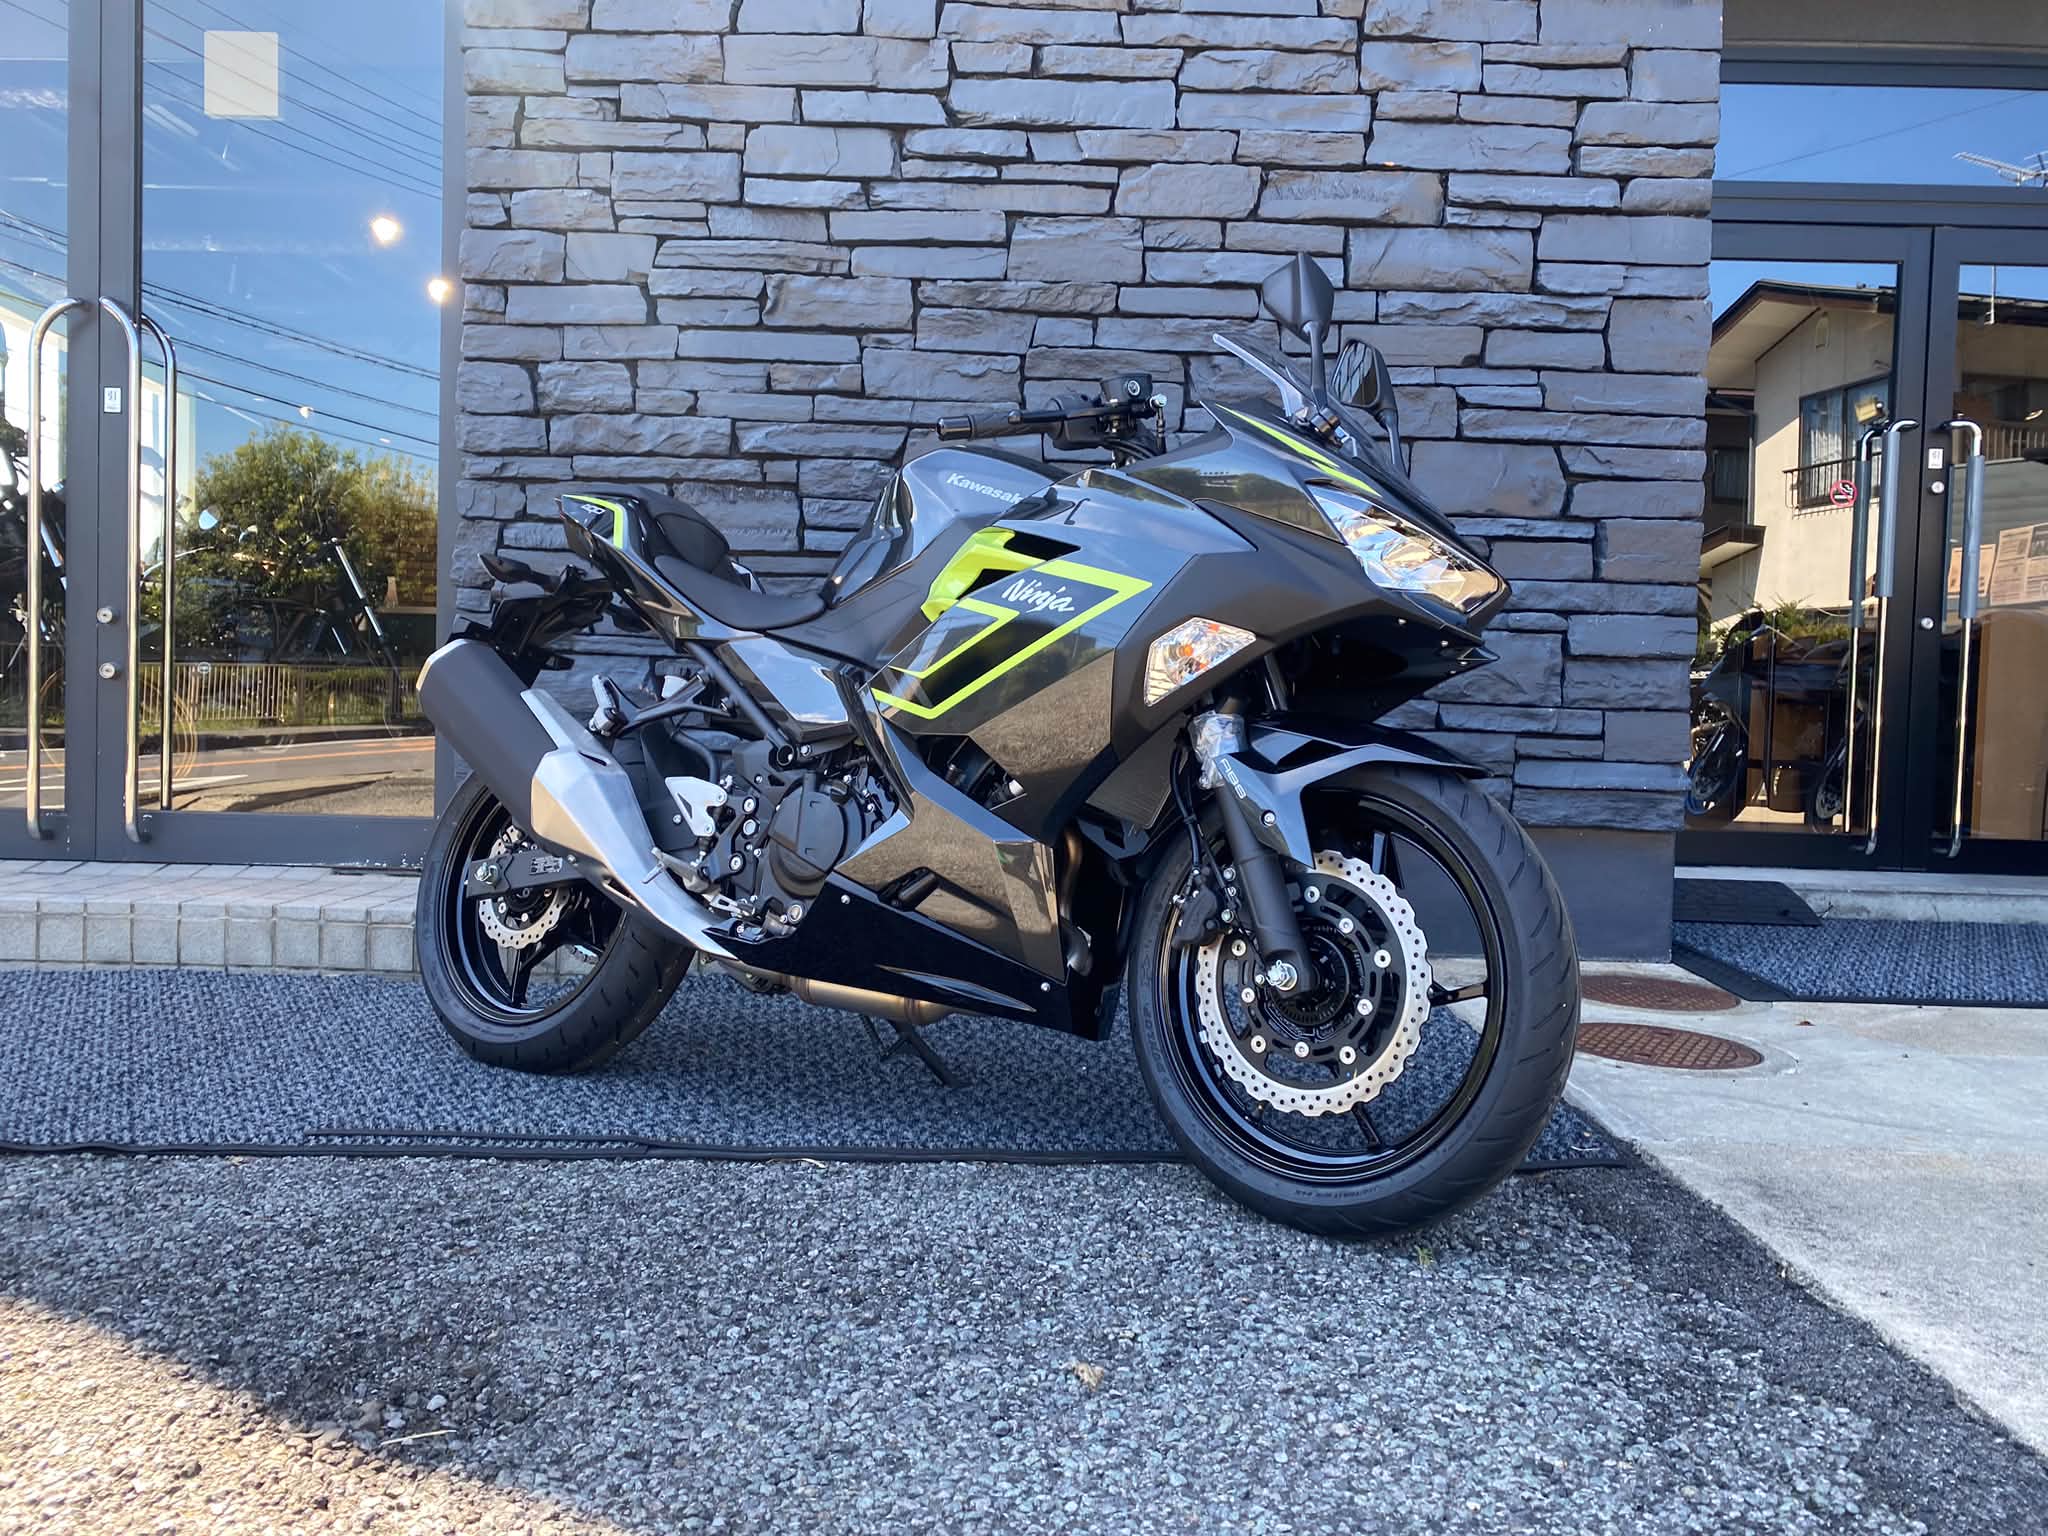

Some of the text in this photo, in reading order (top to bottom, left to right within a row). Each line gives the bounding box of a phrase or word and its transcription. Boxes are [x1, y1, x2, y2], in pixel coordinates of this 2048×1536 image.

[946, 473, 1024, 504] Kawasak
[1001, 578, 1075, 613] Ninja
[1220, 758, 1247, 799] ABS
